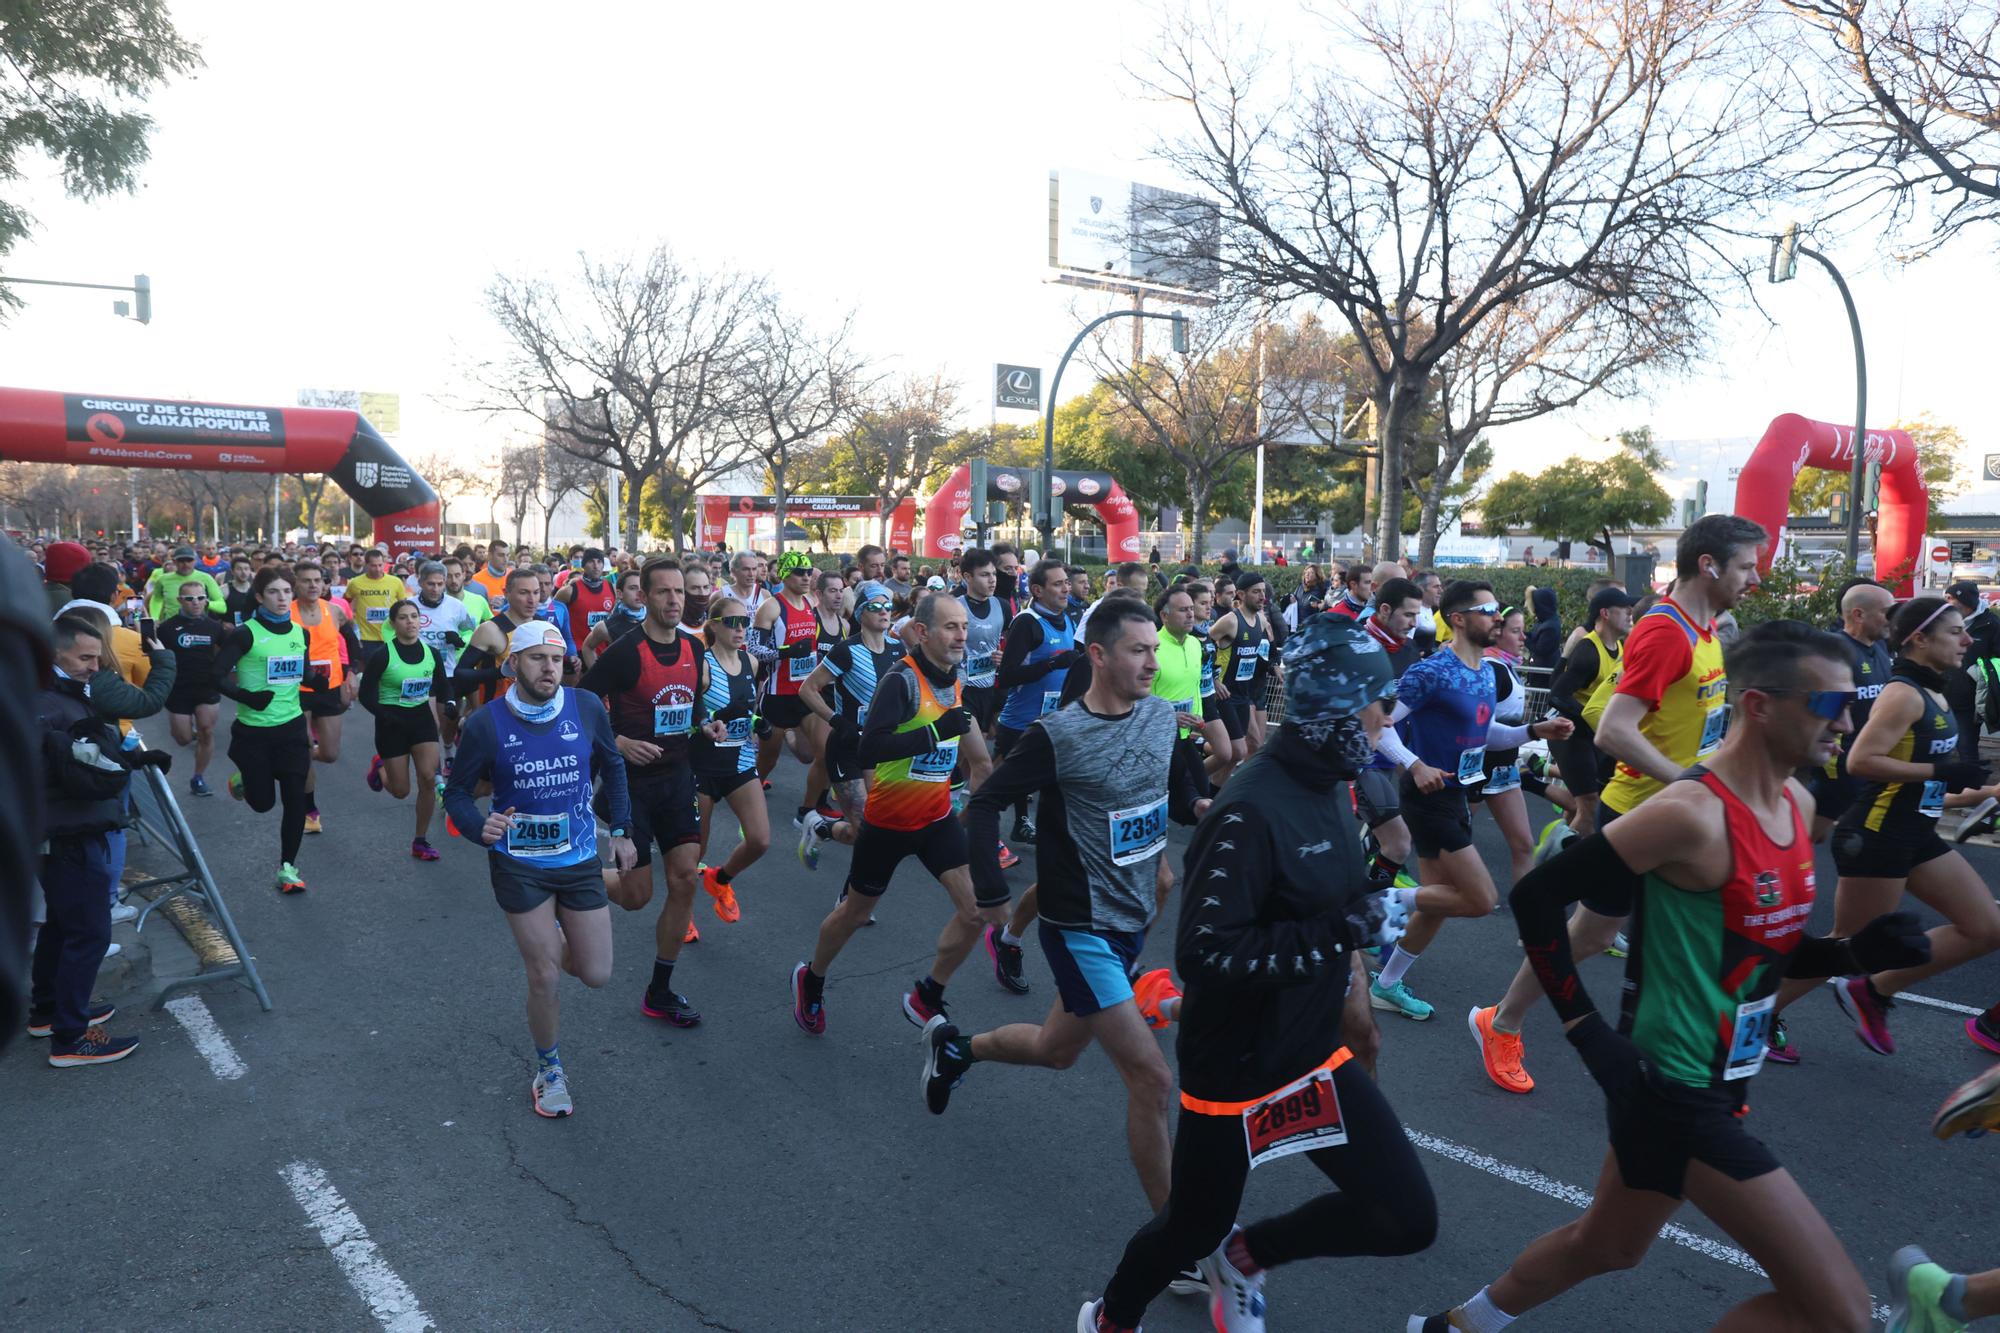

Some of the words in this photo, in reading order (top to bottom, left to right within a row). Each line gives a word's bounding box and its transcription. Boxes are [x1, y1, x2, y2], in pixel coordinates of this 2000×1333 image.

[1000, 395, 1038, 405] LEXUS
[82, 400, 150, 413] CIRCUIT
[154, 405, 178, 415] DE
[180, 406, 268, 421] CARRERES
[89, 447, 192, 460] #ValènciaCorre
[361, 589, 390, 597] REDOLAT
[274, 661, 297, 672] 2412
[514, 755, 578, 775] POBLATS
[513, 770, 580, 789] MARÍTIMS
[533, 784, 579, 799] València
[516, 822, 561, 840] 2496
[1120, 808, 1160, 842] 2353
[1256, 1083, 1322, 1137] 2899
